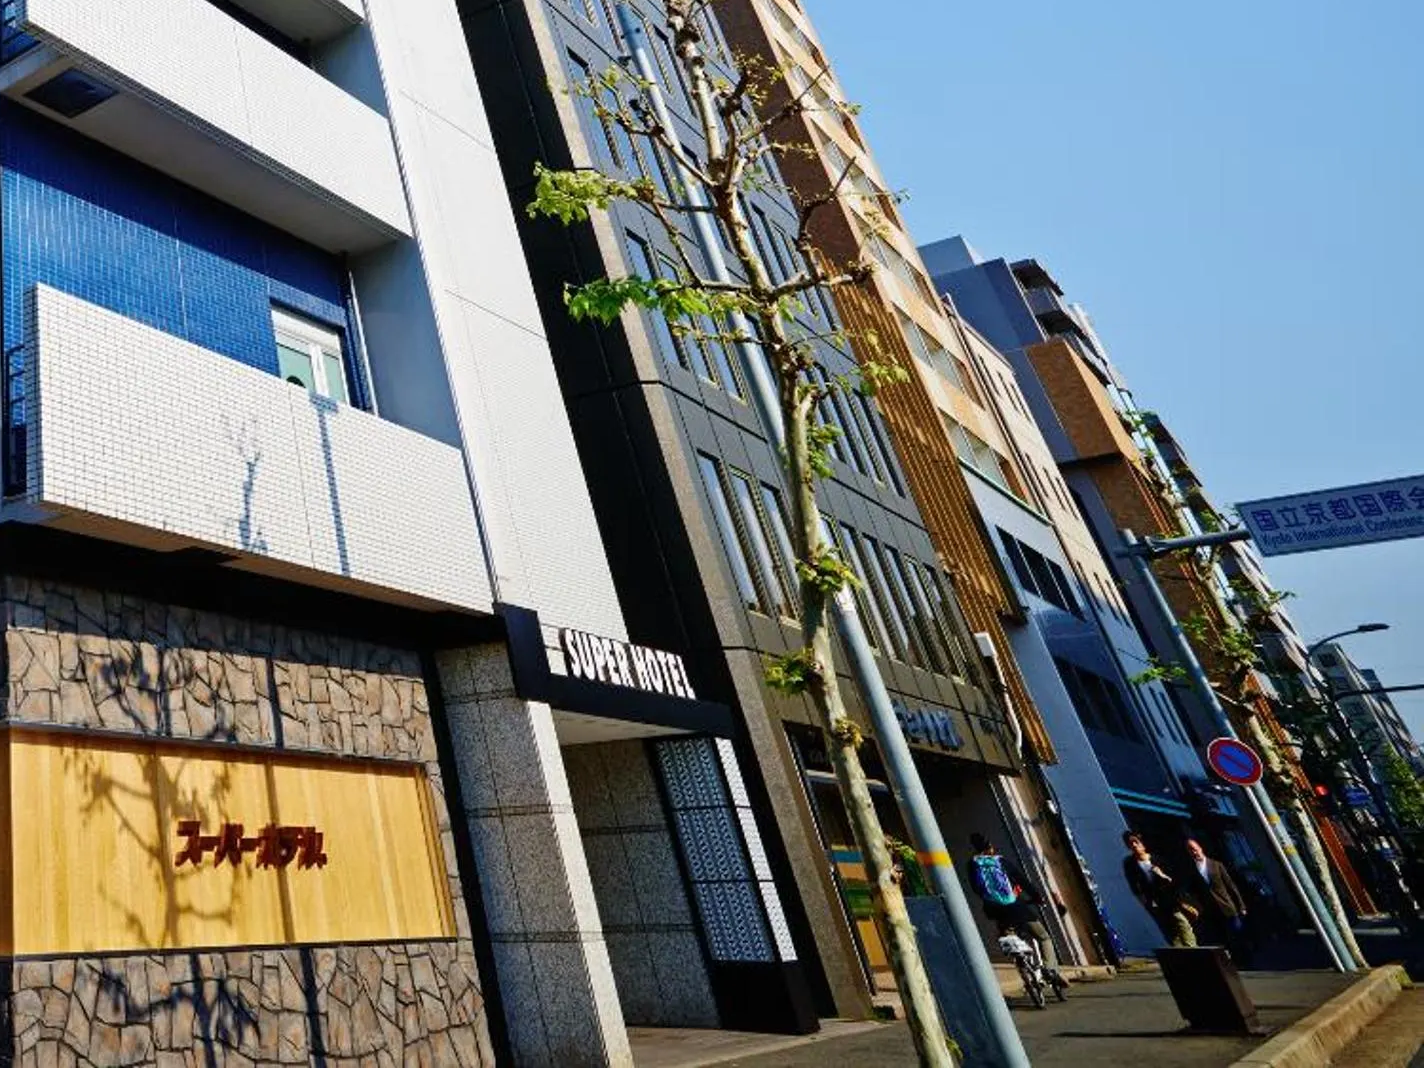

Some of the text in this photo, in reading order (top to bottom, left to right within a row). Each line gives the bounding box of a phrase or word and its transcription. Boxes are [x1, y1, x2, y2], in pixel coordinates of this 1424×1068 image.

[1259, 532, 1294, 548] Kyoto
[1291, 522, 1365, 543] International
[565, 628, 696, 700] SUPER HOTEL
[175, 820, 328, 870] スーパーホテル
